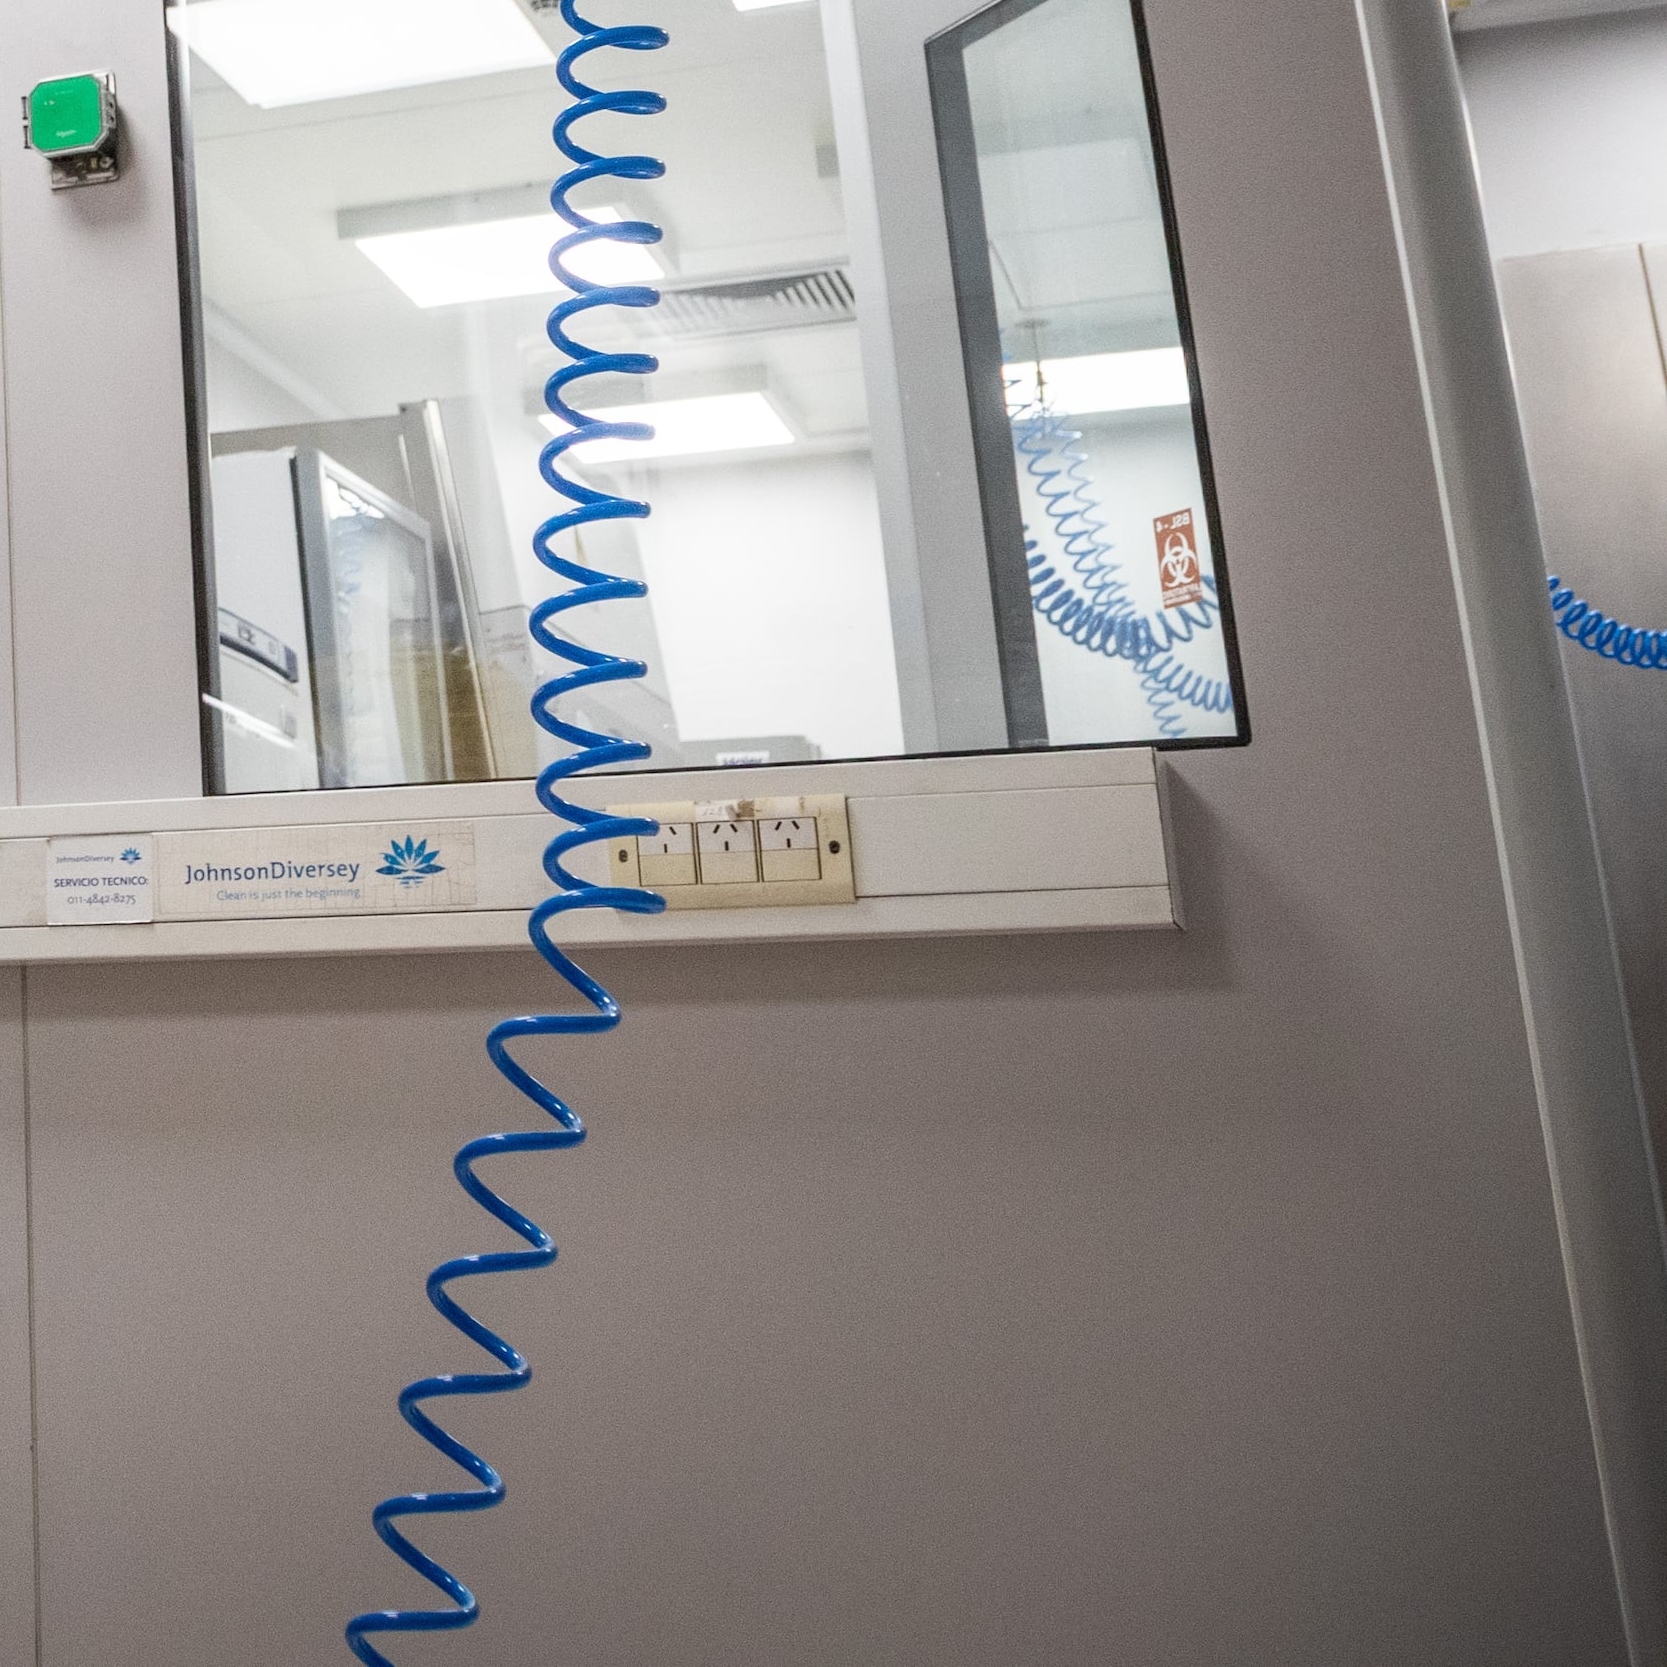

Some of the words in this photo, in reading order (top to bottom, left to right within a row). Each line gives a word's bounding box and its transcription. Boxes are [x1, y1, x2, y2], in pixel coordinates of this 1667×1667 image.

[56, 855, 114, 864] JohnsonDiversey
[185, 861, 360, 885] JohnsonDiversey
[54, 878, 99, 888] SERVICIO
[101, 876, 149, 886] TECNICO:
[67, 893, 136, 906] 011-4842-8275
[217, 890, 247, 901] Clean
[249, 889, 260, 900] is
[261, 889, 282, 902] just
[284, 888, 303, 899] the
[305, 886, 360, 901] beginning
